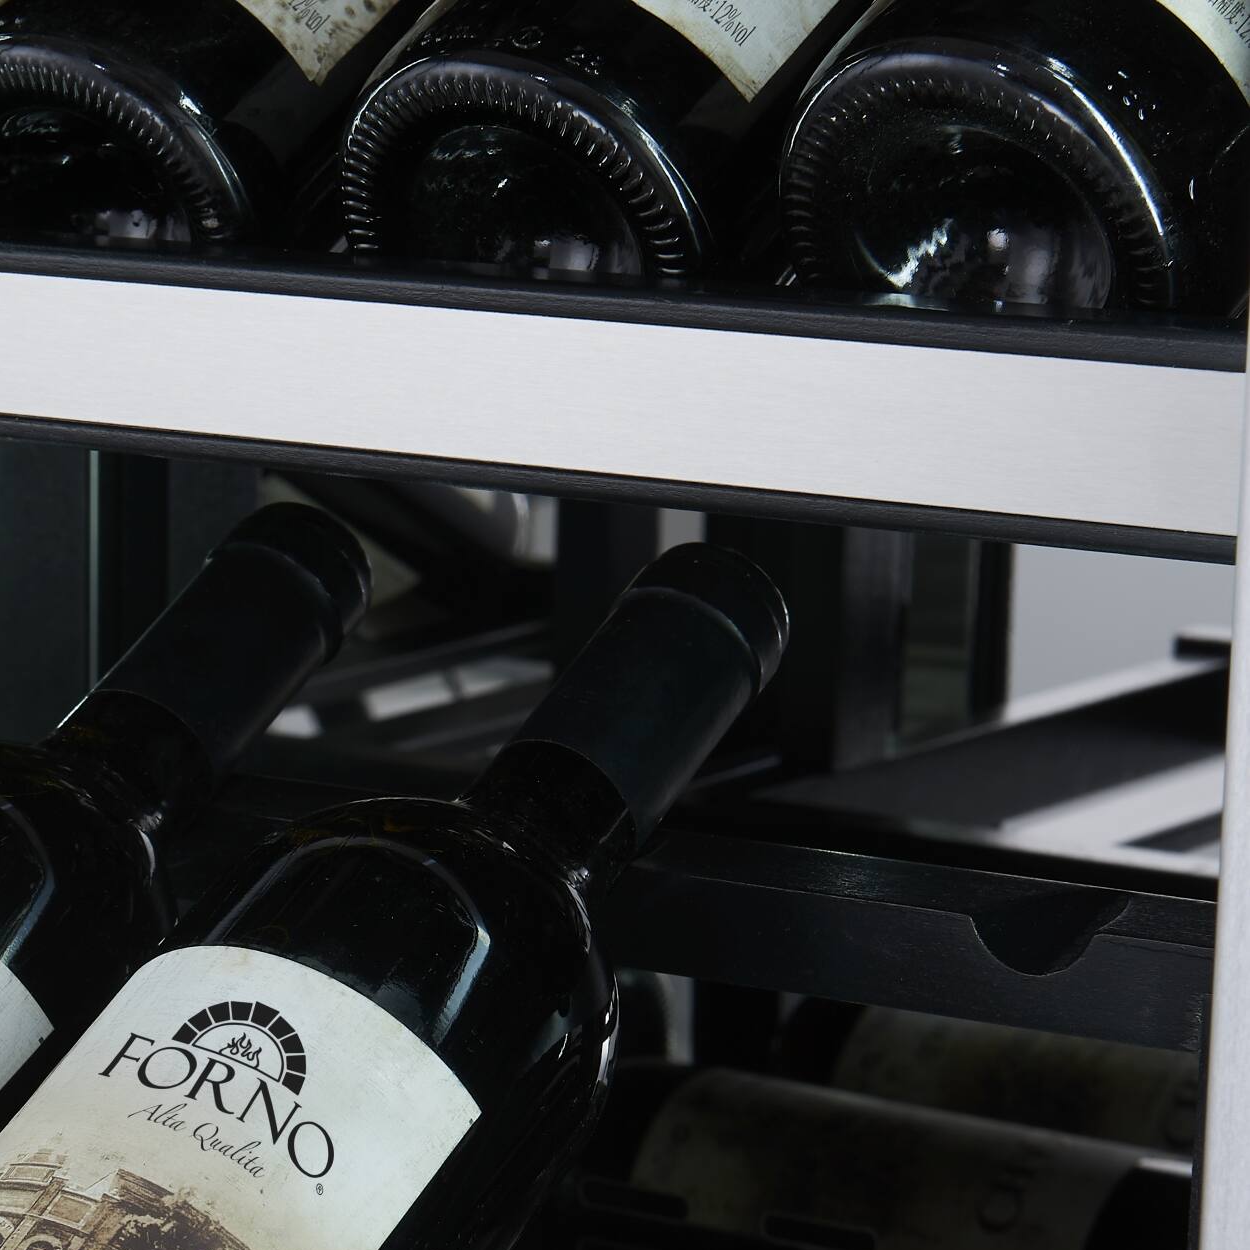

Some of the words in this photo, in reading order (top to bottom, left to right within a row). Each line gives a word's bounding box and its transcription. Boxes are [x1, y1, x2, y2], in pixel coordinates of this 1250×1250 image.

[288, 0, 331, 34] 2%vol
[98, 1032, 335, 1179] FORNO
[127, 1102, 188, 1132] Alta
[191, 1122, 266, 1178] Qualita
